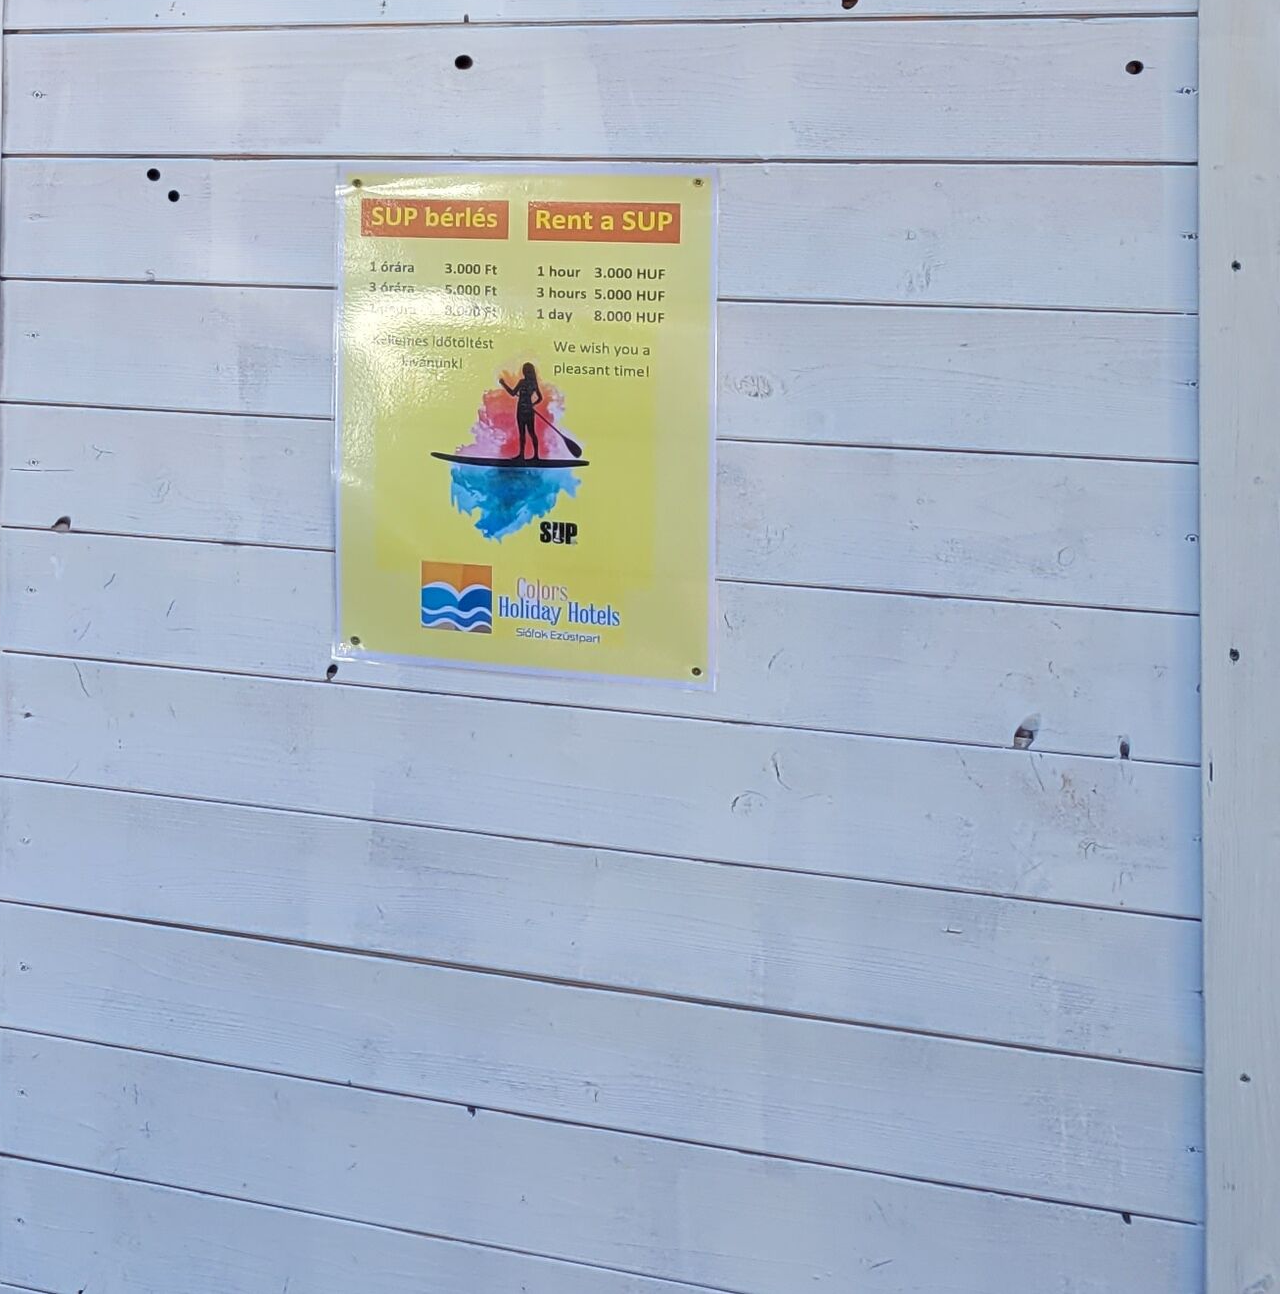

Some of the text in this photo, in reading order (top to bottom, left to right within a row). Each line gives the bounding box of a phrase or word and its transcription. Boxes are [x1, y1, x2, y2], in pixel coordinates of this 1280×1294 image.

[371, 206, 498, 228] SUP bérlés
[535, 209, 673, 232] Rent a SUP
[370, 261, 498, 275] 1 órára 3.000 Ft
[537, 265, 666, 280] 1 hour 3.000 HUF
[369, 281, 498, 296] 3 órára 5.000 Ft
[536, 287, 666, 301] 3 hours 5.000 HUF
[536, 308, 665, 323] 1 day 8.000 HUF
[553, 341, 651, 357] We wish you a
[553, 362, 650, 378] pleasant time!
[540, 521, 578, 545] SUP
[516, 577, 569, 601] Colors
[499, 595, 621, 627] Holiday Hotels
[515, 627, 549, 640] Siófok
